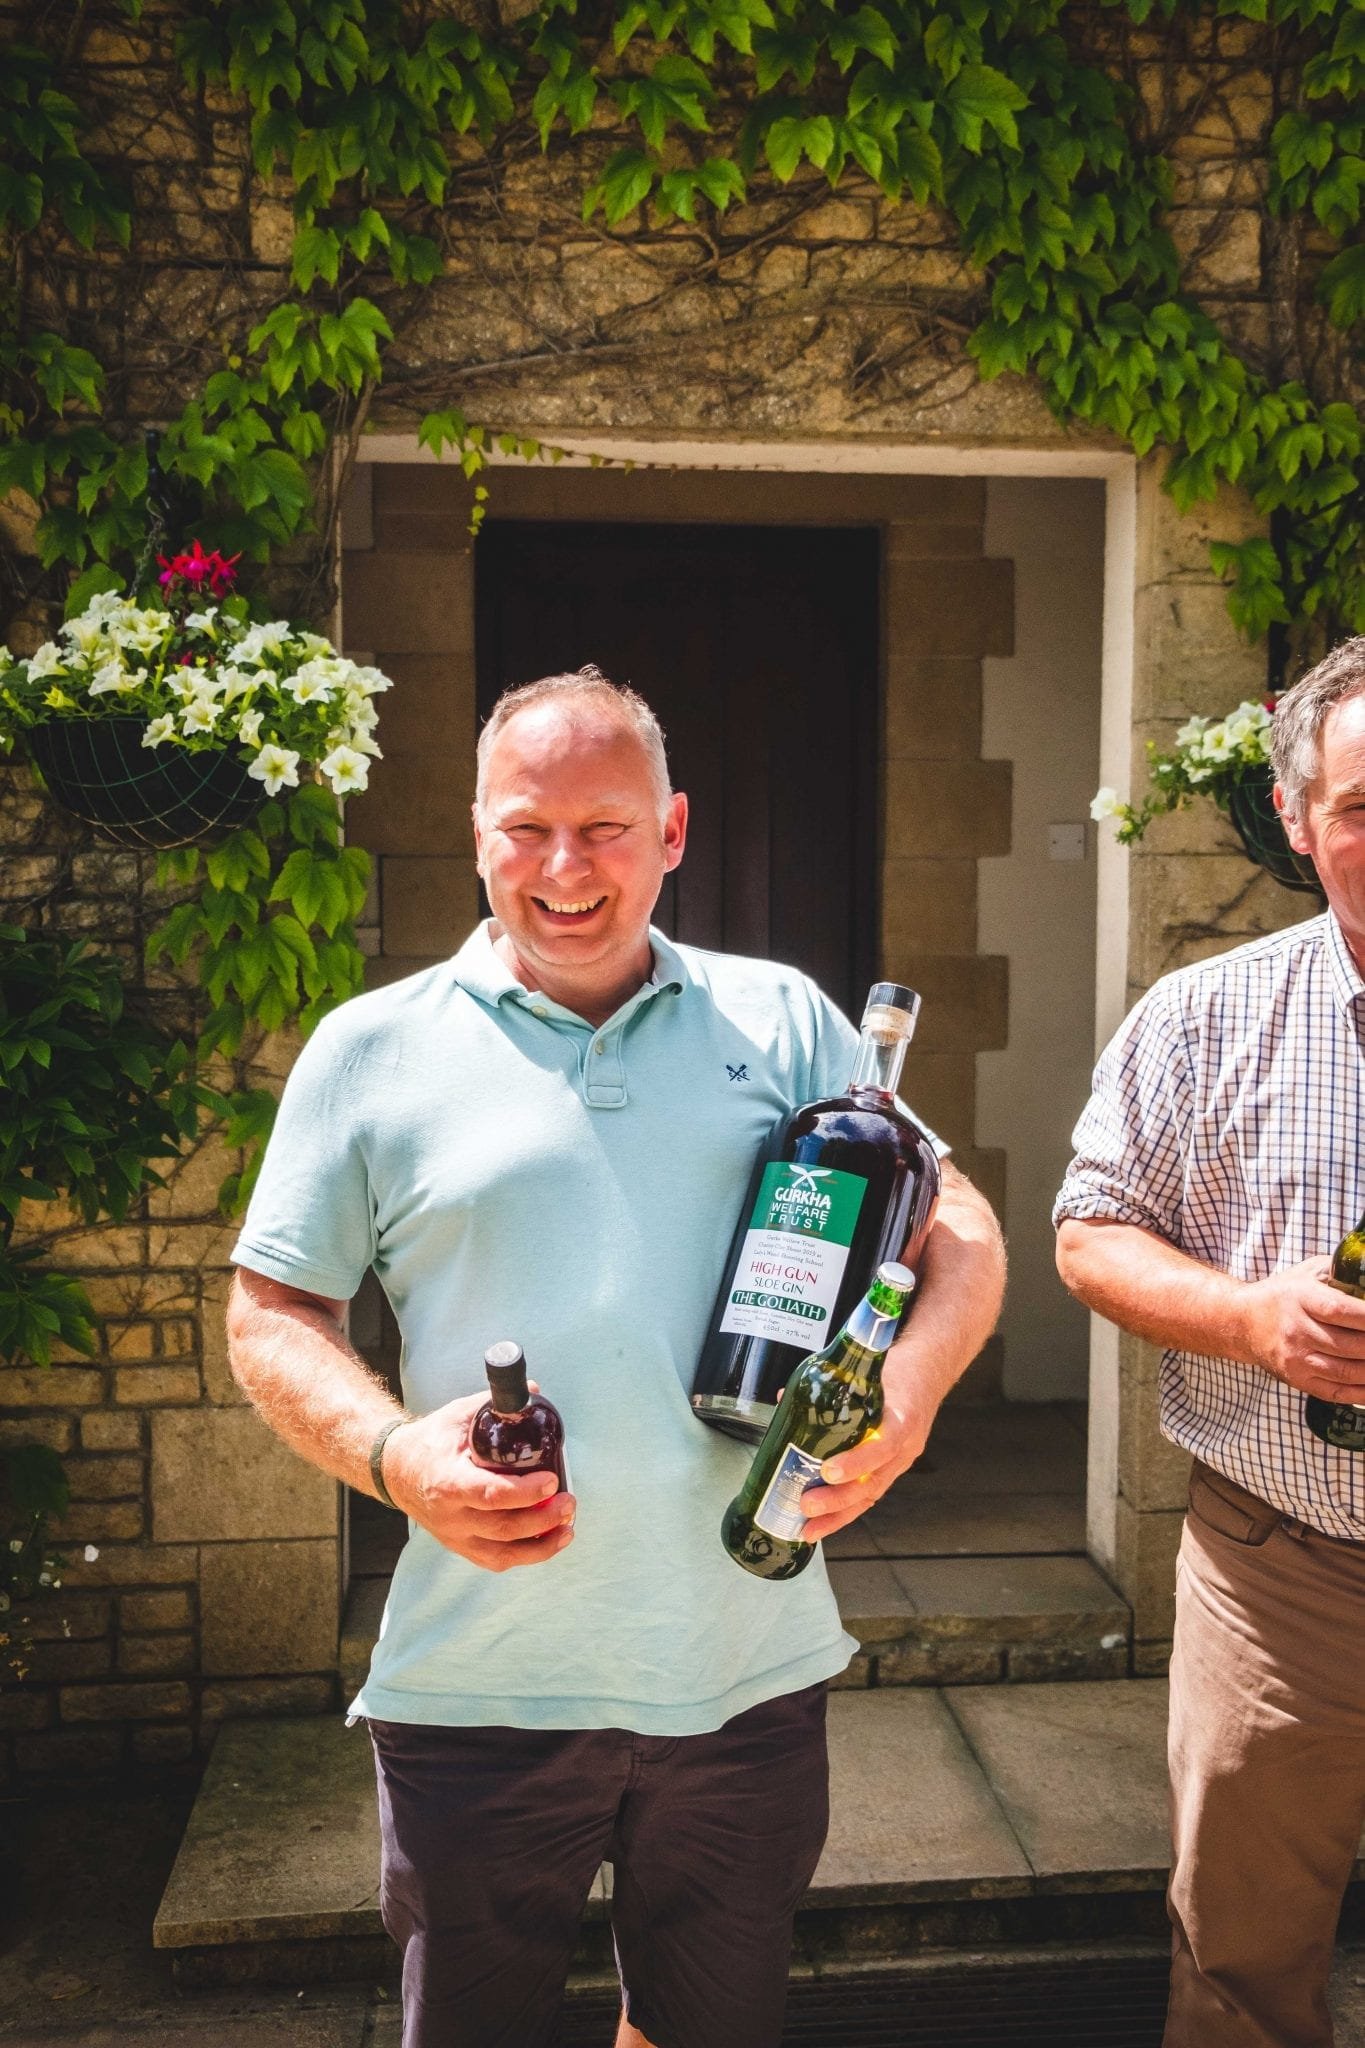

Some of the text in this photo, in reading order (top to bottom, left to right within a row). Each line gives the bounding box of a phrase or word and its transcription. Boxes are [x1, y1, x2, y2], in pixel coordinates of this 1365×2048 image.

[775, 1187, 832, 1210] GURKHA
[769, 1212, 827, 1231] TRUST
[772, 1202, 830, 1221] WELFARE
[750, 1260, 819, 1285] HIGH GUN
[753, 1276, 805, 1295] SLOE GIN
[735, 1291, 757, 1304] THE
[757, 1294, 822, 1320] GOLIATH
